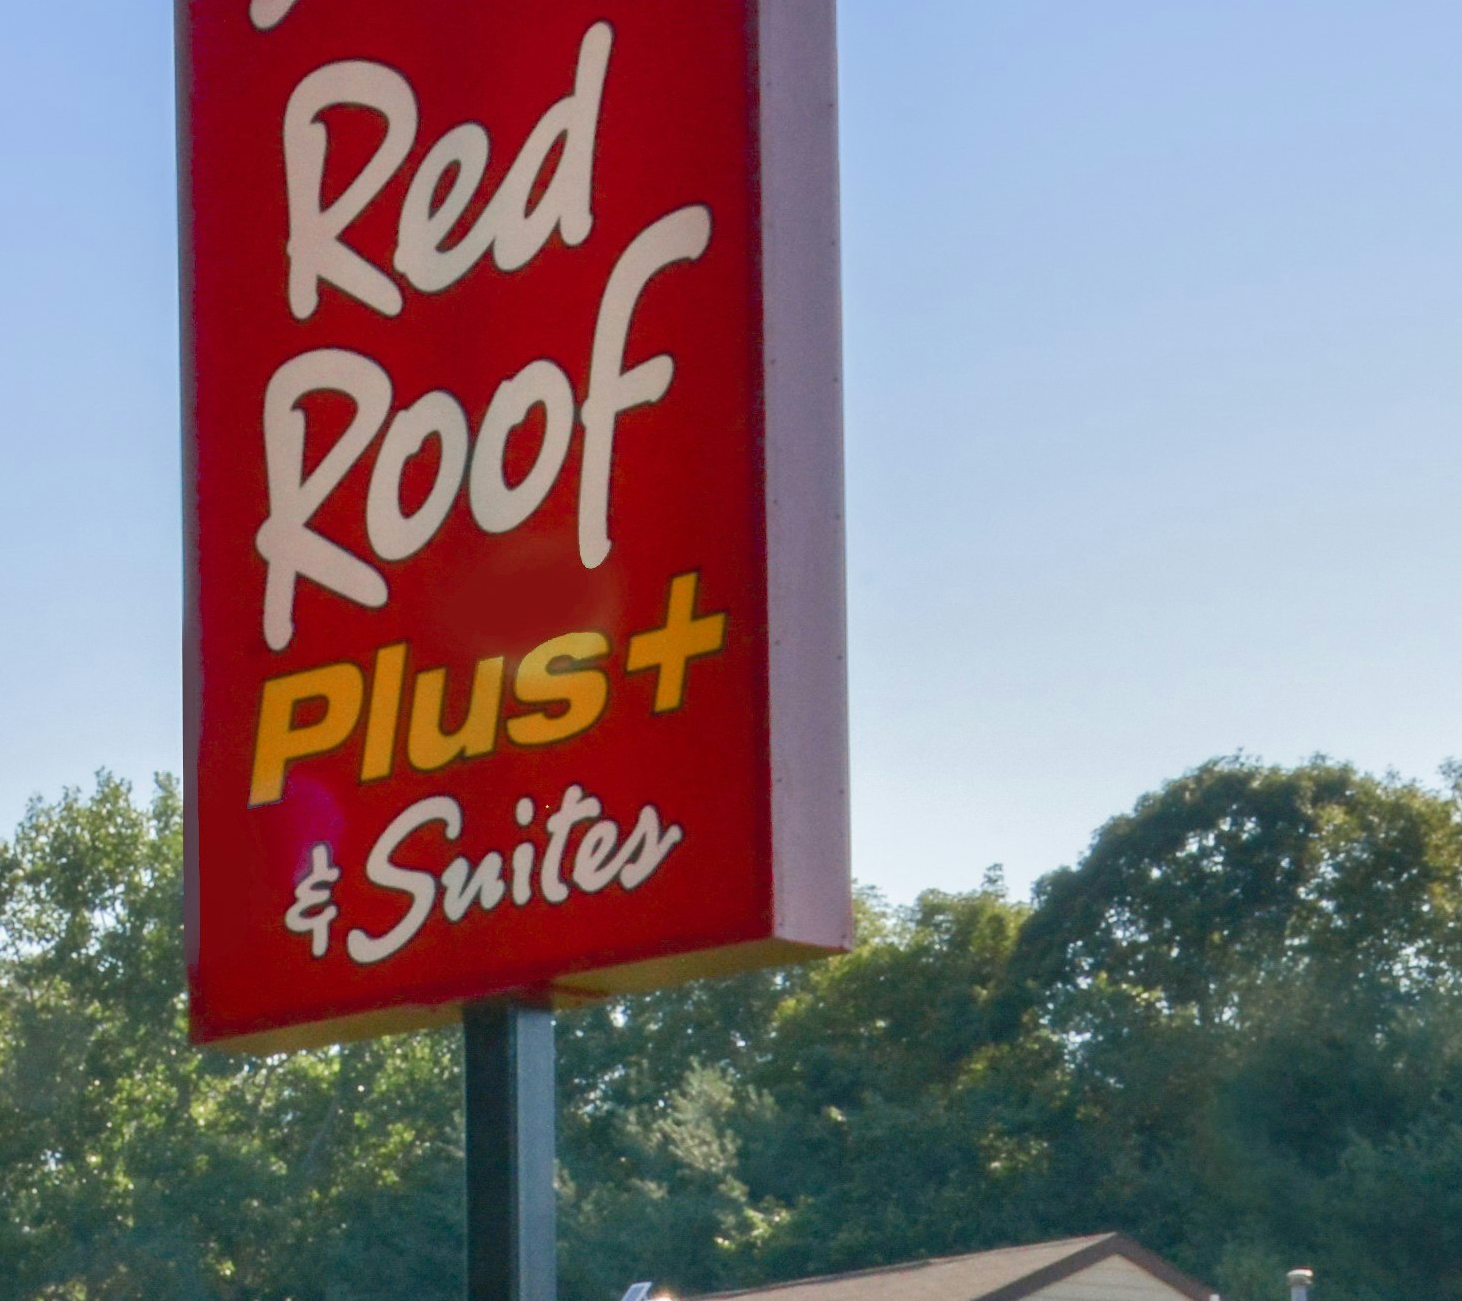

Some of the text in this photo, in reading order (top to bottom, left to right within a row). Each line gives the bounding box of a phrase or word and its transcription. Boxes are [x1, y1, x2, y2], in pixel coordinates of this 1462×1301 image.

[282, 21, 613, 319] Red
[256, 204, 712, 650] Roof
[248, 572, 726, 807] Plus+
[285, 784, 683, 965] & Suites
